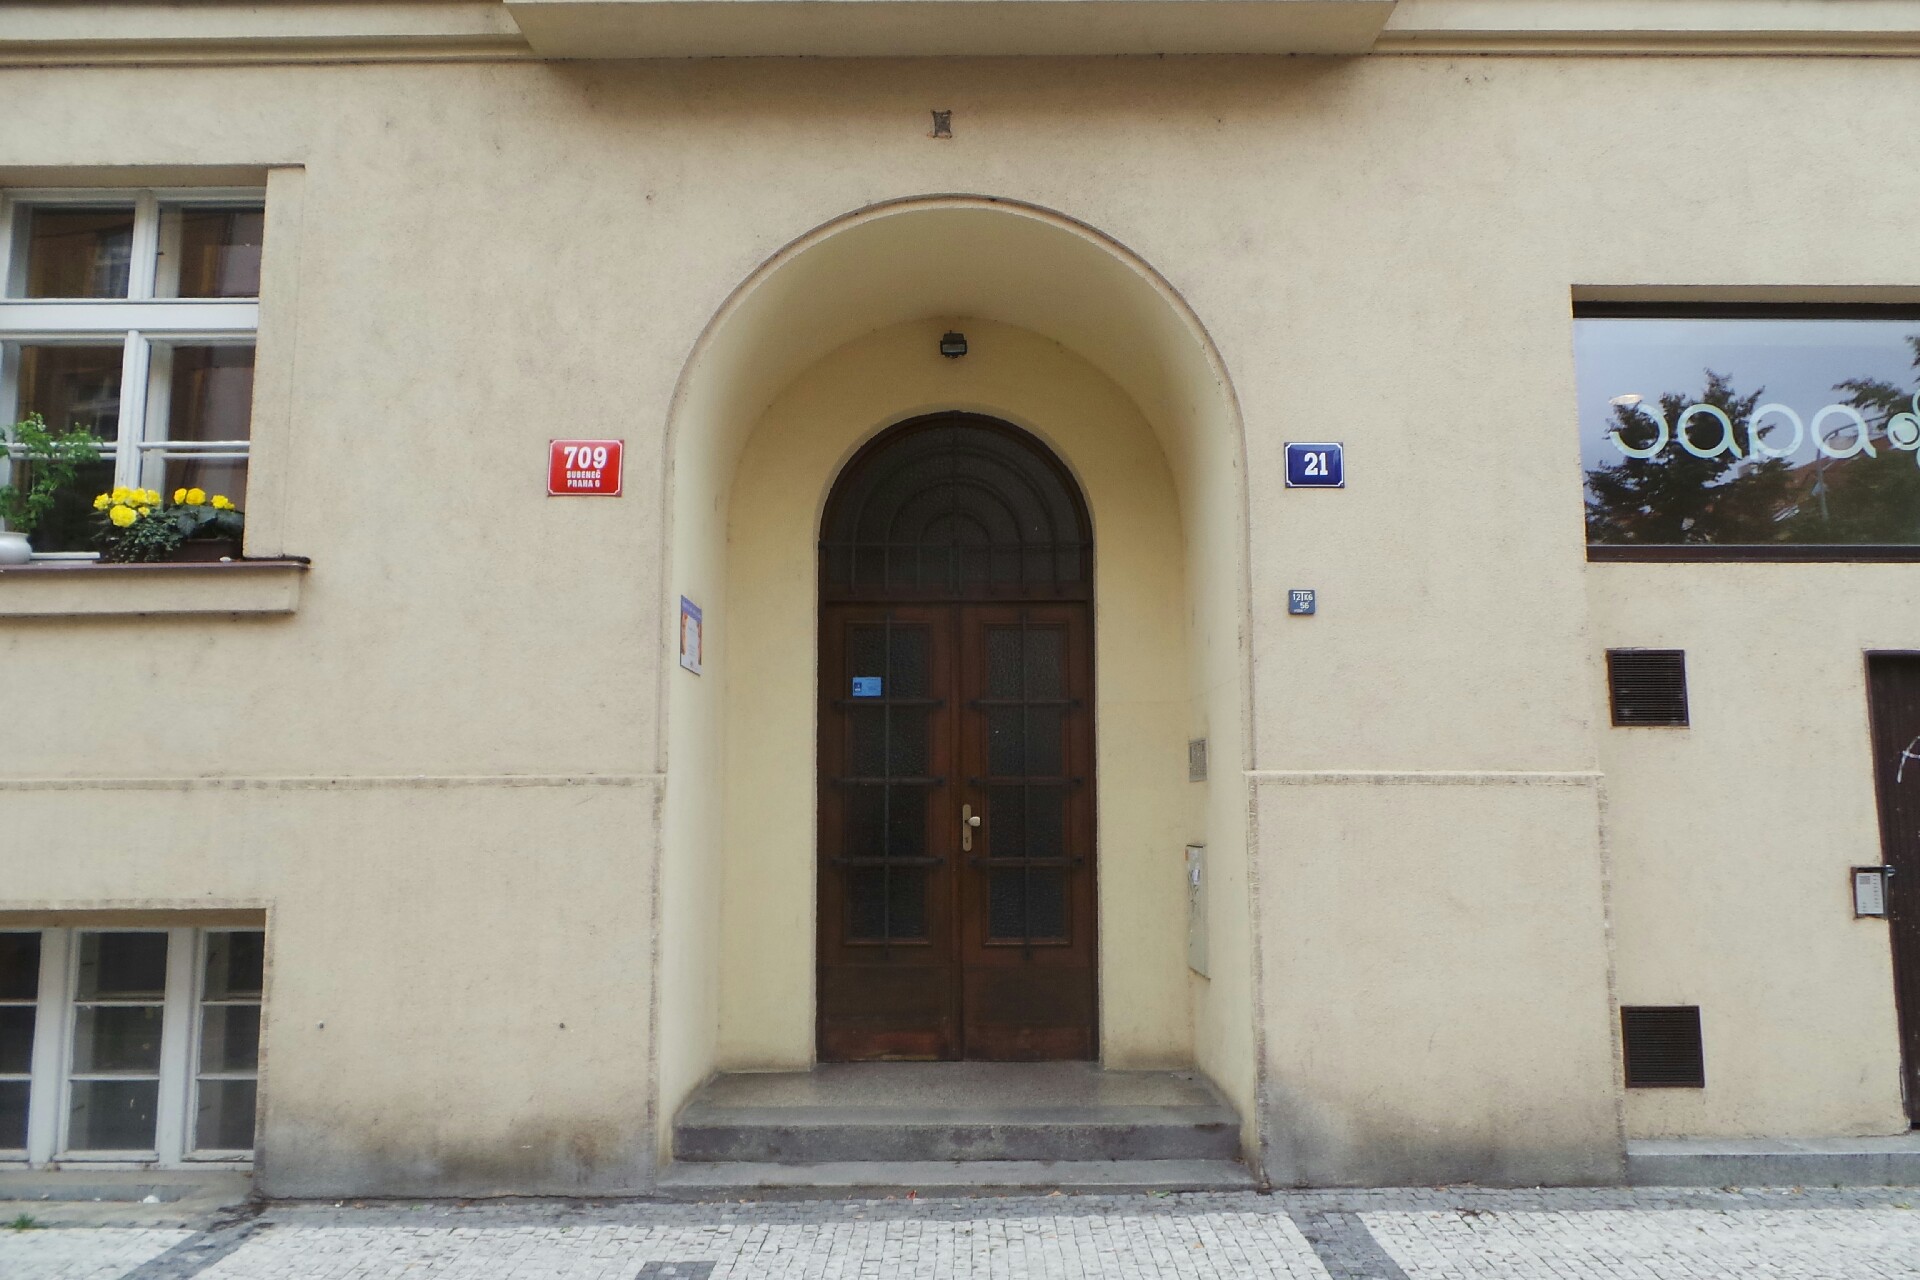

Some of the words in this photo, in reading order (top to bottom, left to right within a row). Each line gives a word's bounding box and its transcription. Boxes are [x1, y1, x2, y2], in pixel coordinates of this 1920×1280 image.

[564, 446, 607, 469] 709
[1304, 452, 1328, 475] 21
[567, 480, 593, 488] PRAHA
[594, 480, 600, 488] 6
